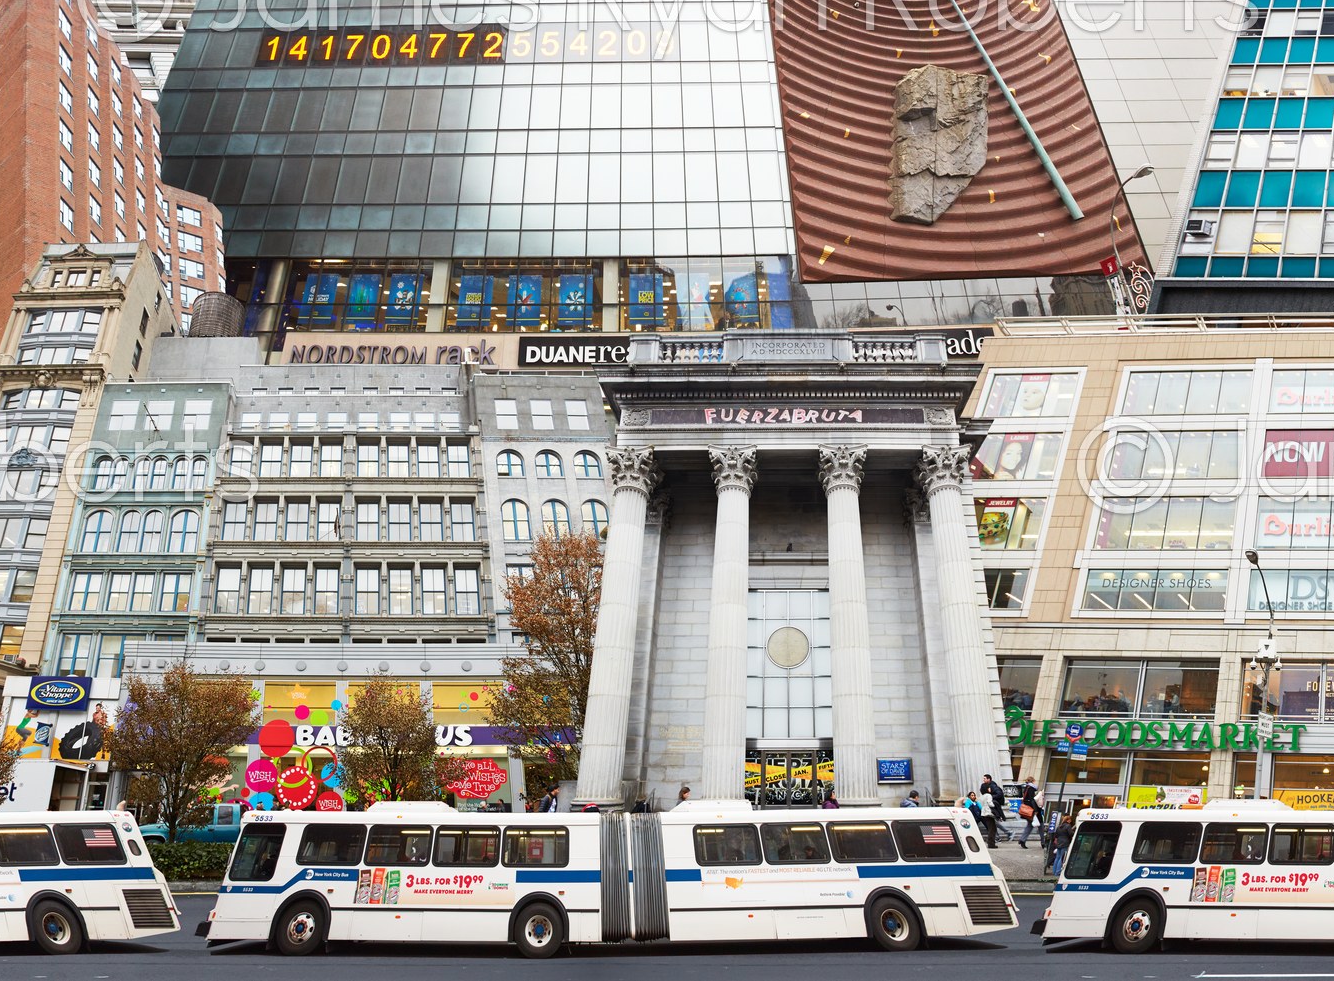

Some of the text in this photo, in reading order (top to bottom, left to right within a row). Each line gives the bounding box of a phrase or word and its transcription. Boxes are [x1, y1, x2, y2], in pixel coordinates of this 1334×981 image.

[289, 339, 497, 366] NORDSTROM rack
[704, 407, 863, 424] FUERZABRUTA
[1264, 441, 1325, 462] NOW
[1102, 578, 1213, 588] DESIGNER SHOES.
[1259, 601, 1304, 610] DESIGNER
[1307, 601, 1333, 610] SHOE
[39, 691, 73, 699] Shoppe
[46, 684, 78, 693] Vitamin
[1005, 719, 1060, 746] OLE
[1067, 720, 1165, 748] OODS
[765, 773, 786, 782] CLOSE
[794, 769, 808, 777] JAN.
[406, 875, 414, 888] 3
[1242, 873, 1250, 886] 3
